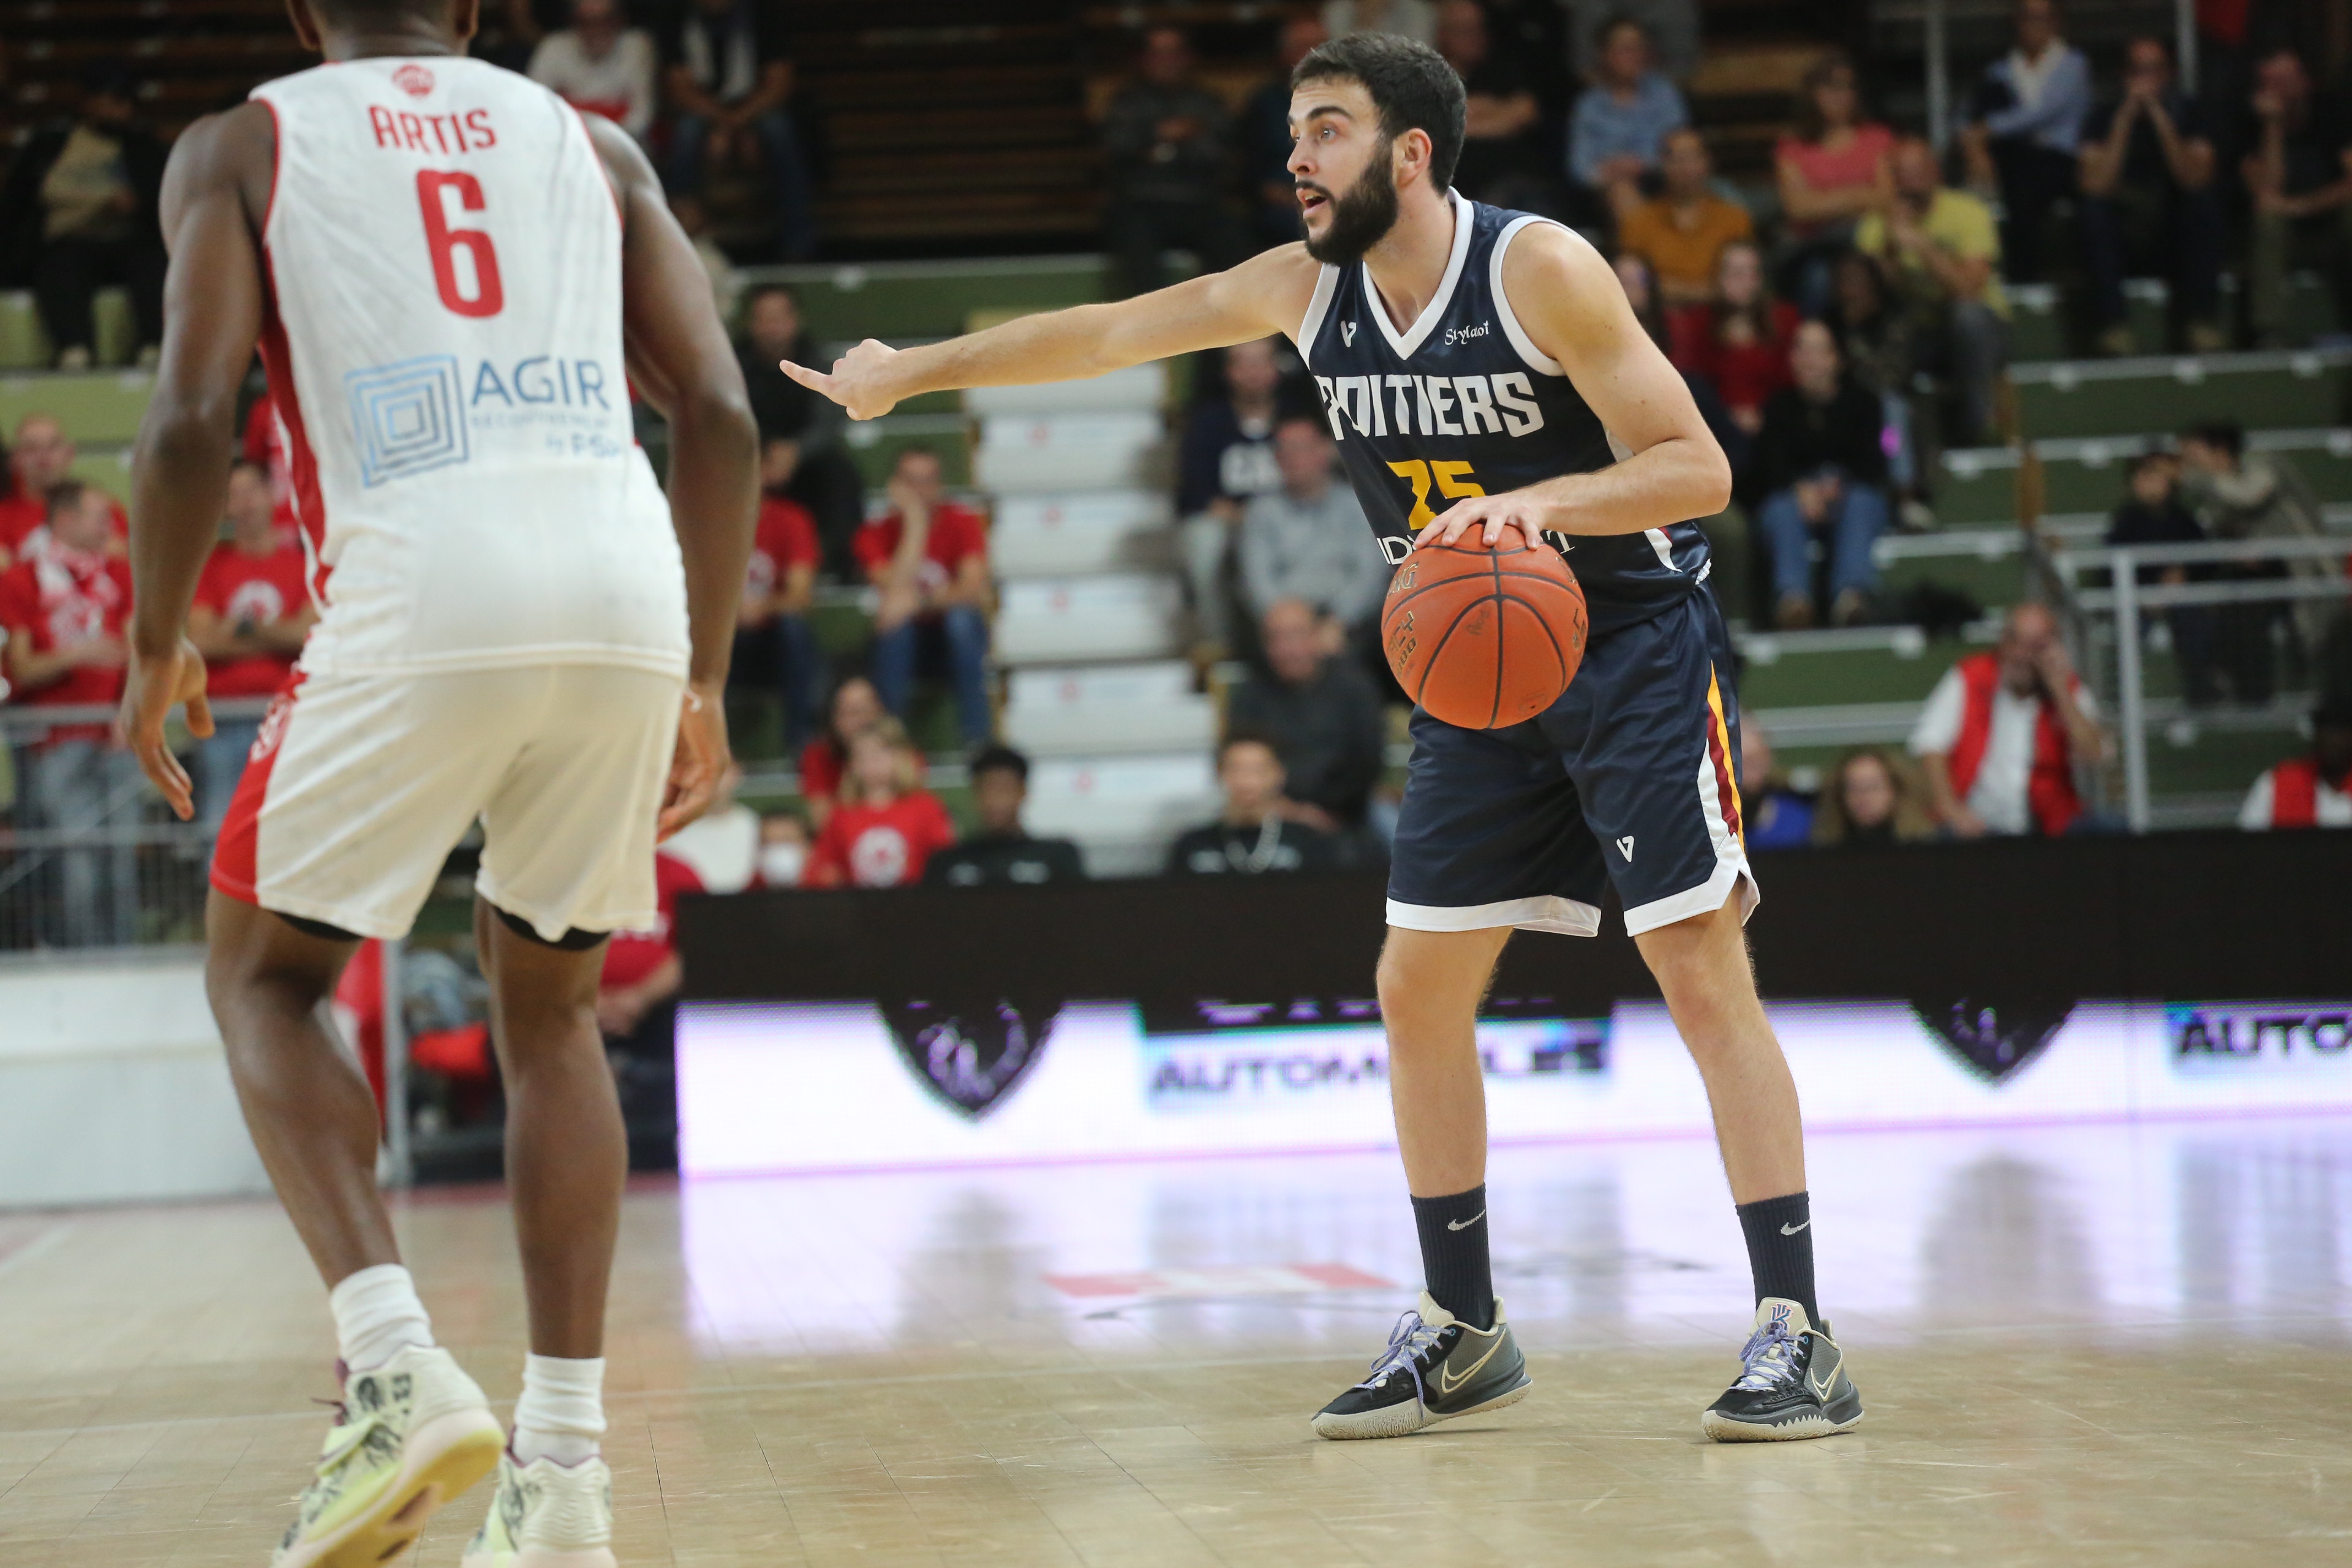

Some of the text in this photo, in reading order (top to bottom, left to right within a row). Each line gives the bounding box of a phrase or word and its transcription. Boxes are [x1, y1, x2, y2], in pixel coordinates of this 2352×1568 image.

[369, 105, 497, 156] ARTIS
[415, 167, 505, 318] 6
[470, 355, 611, 411] AGIR
[2179, 1016, 2352, 1056] AUTO
